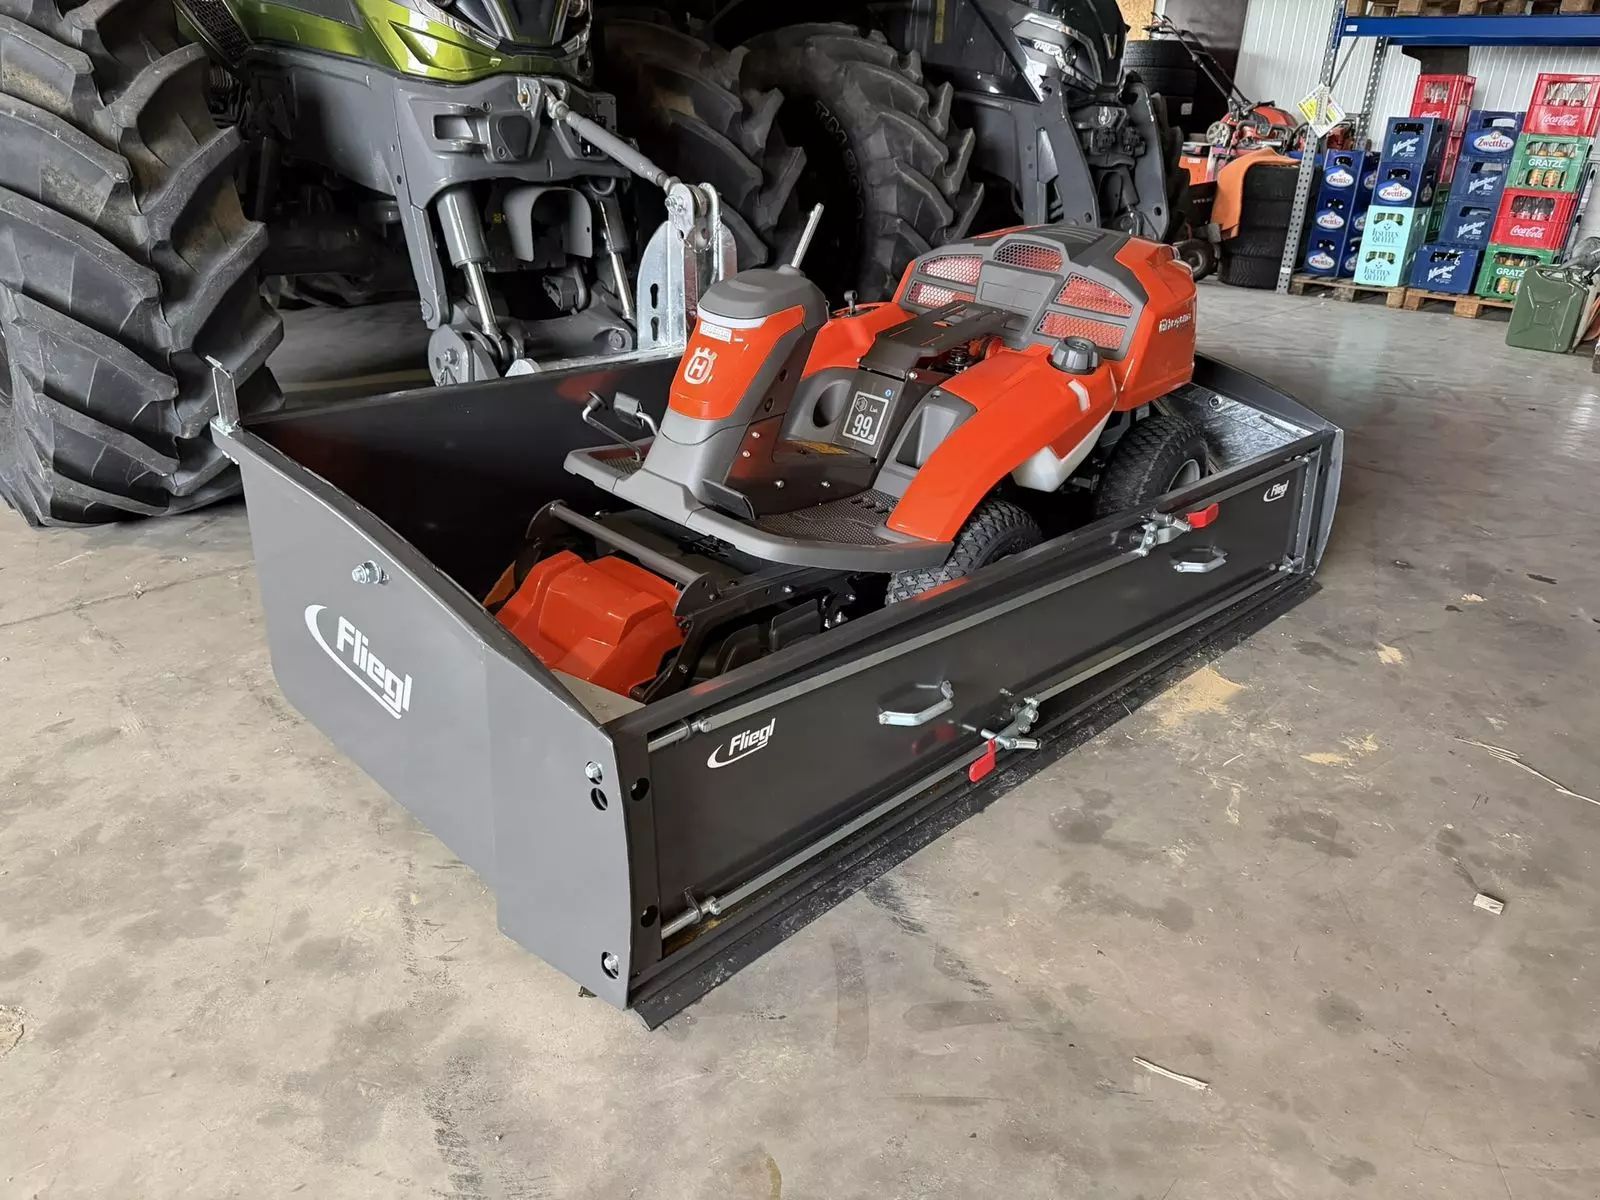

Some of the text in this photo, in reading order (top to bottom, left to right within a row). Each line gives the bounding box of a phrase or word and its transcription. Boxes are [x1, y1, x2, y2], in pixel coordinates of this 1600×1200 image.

[1541, 113, 1579, 127] Coca-Cola
[1477, 137, 1510, 149] Zwettler
[1510, 225, 1546, 239] Coca-Cola
[852, 413, 873, 438] 99
[1270, 480, 1290, 497] Fliegl
[336, 616, 413, 713] Fliegl
[728, 717, 776, 757] Fliegl
